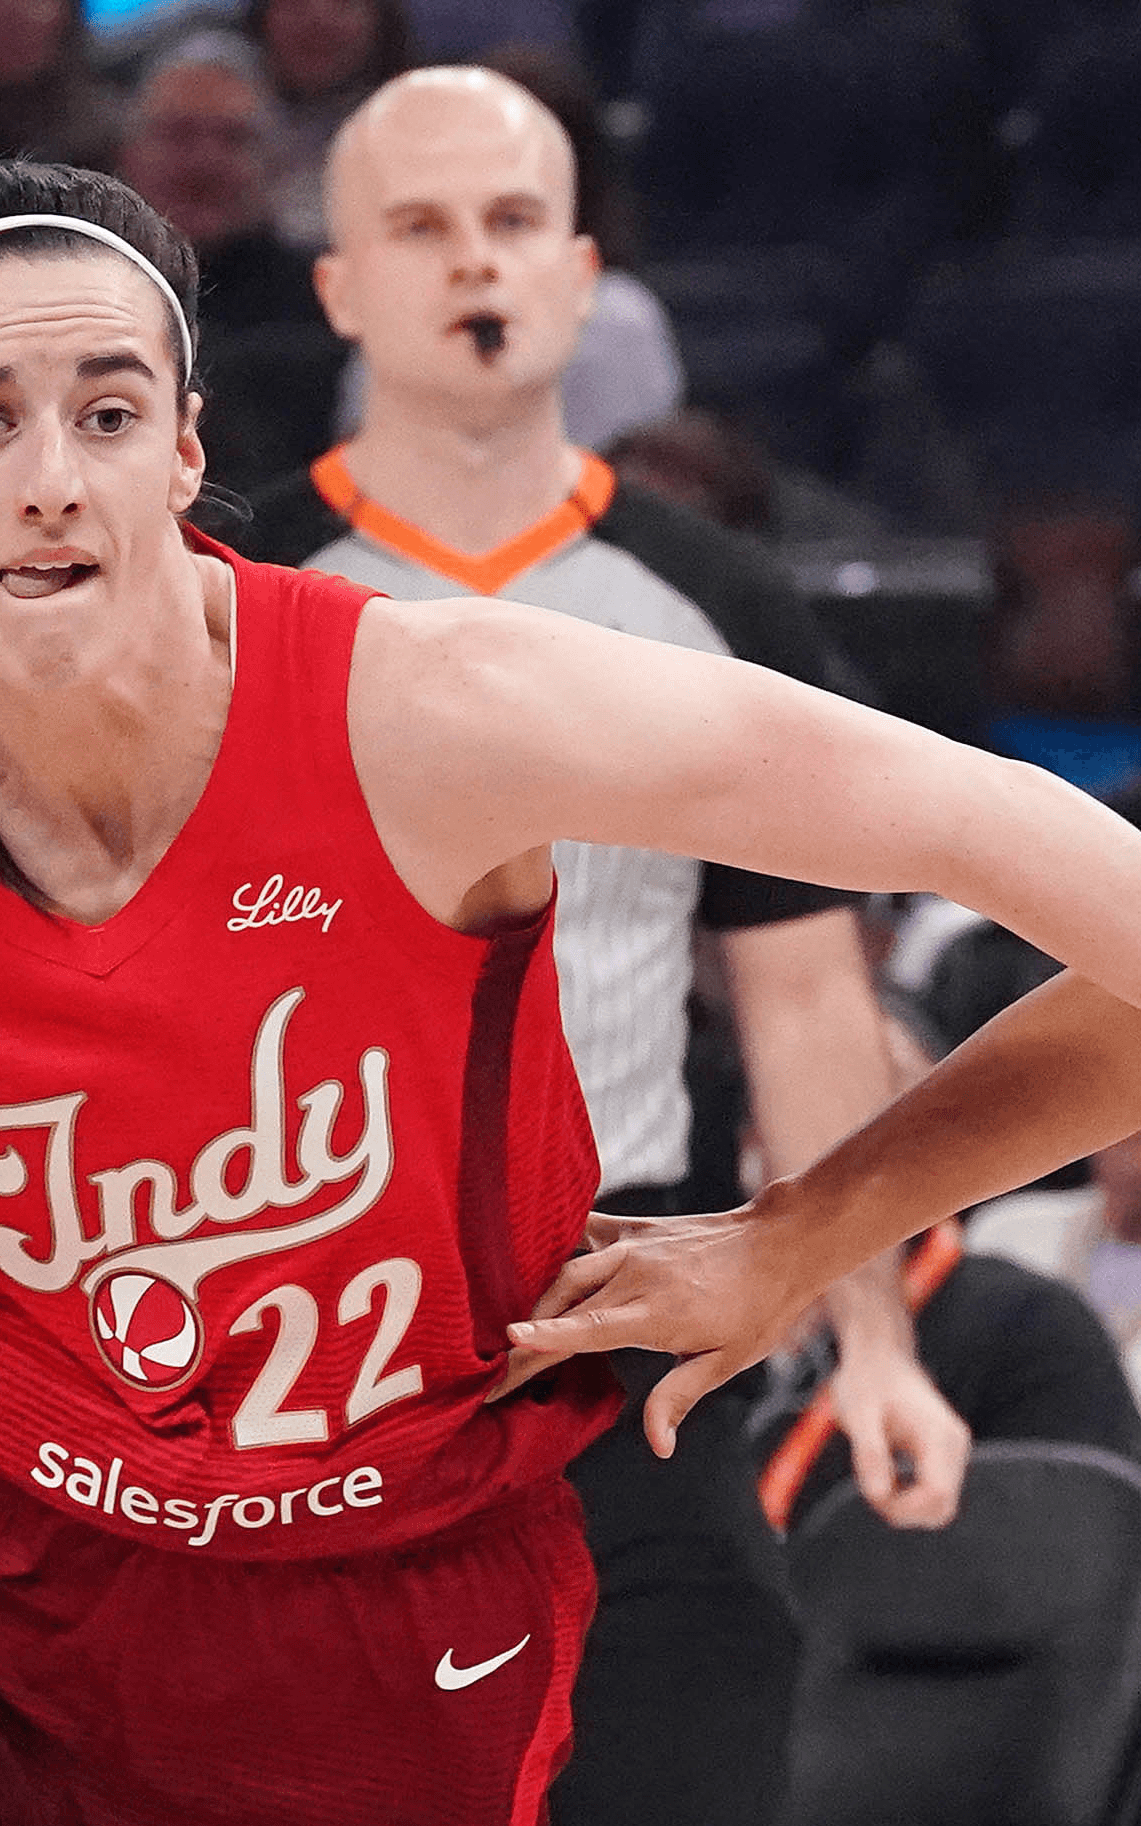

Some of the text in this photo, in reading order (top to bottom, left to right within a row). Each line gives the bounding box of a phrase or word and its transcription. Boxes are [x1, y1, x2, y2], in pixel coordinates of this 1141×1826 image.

[226, 873, 344, 933] Lilly
[229, 1256, 424, 1450] 22
[30, 1441, 384, 1546] salesforce
